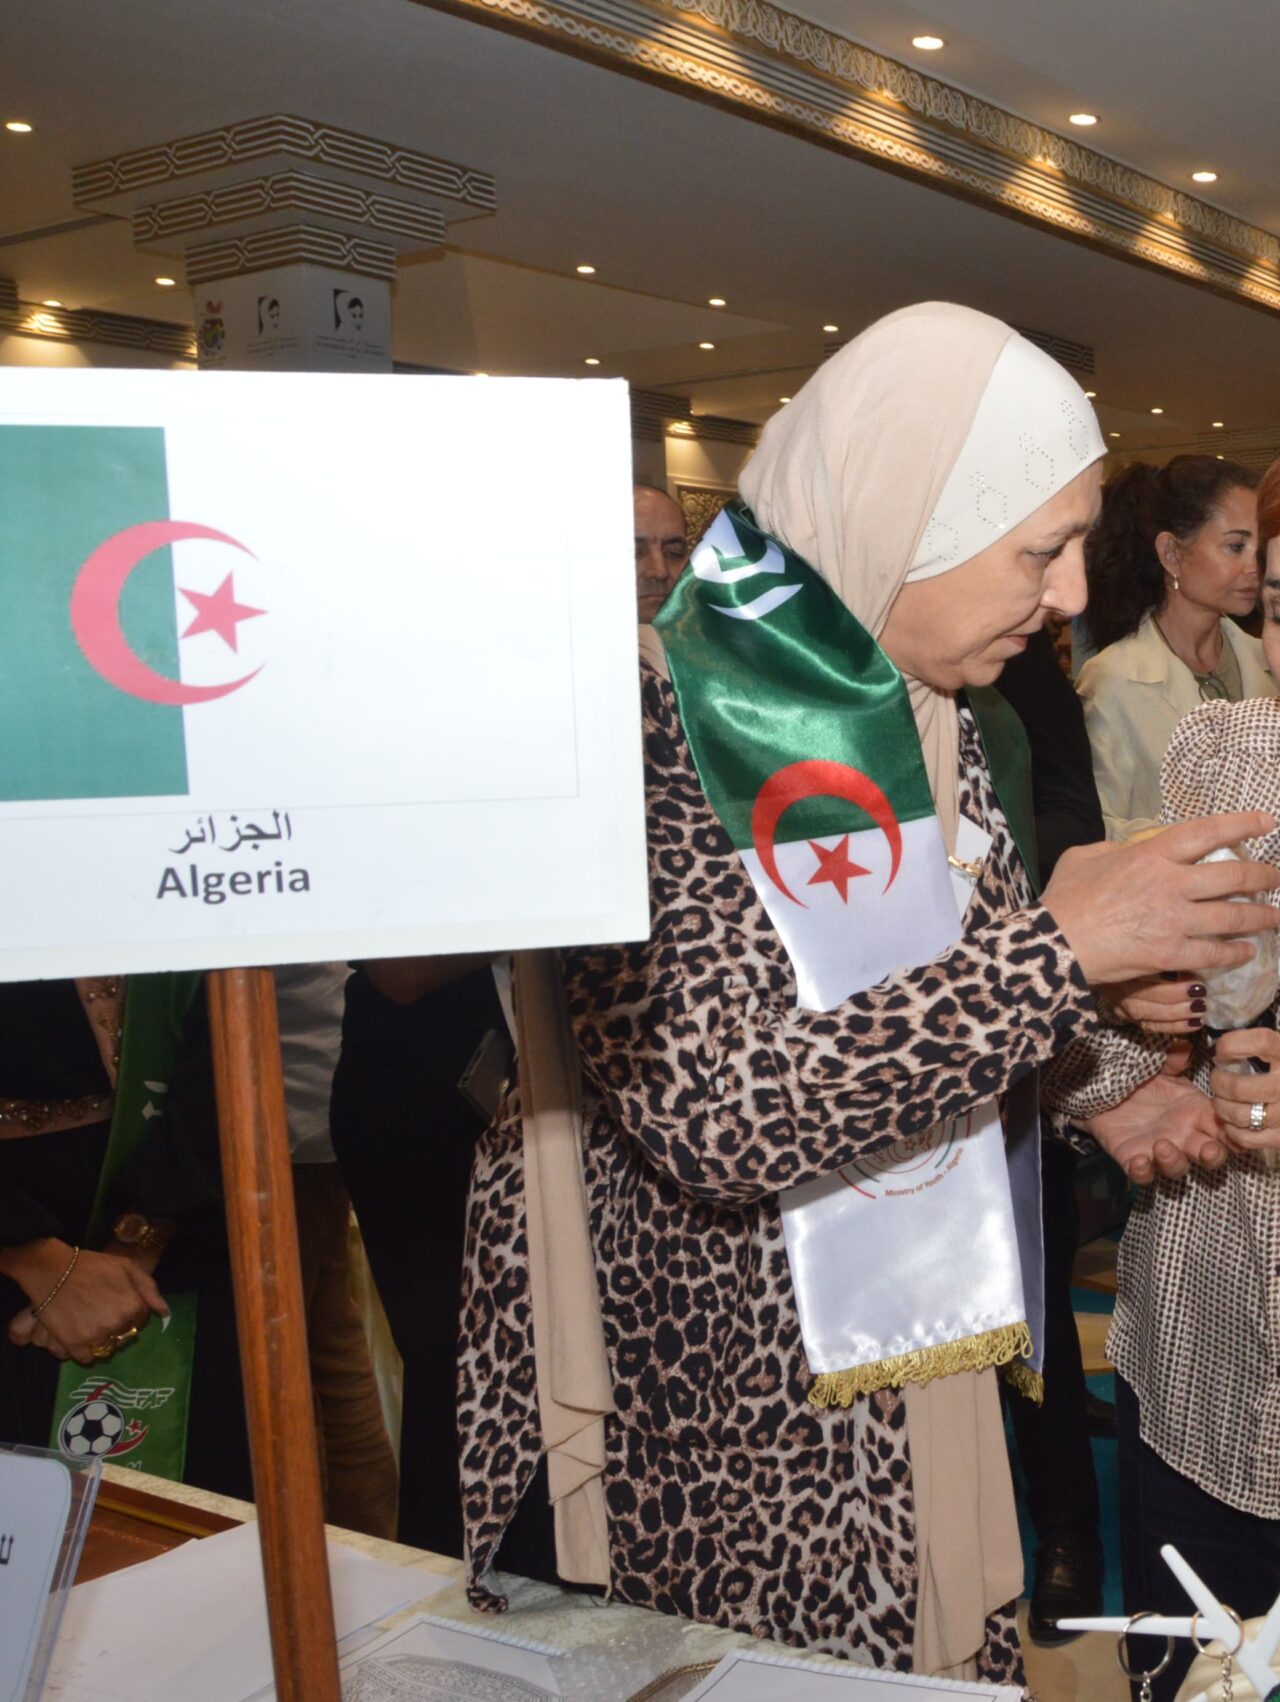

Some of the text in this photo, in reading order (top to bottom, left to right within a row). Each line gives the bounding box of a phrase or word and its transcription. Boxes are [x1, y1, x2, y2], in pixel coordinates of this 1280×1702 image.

[169, 810, 293, 854] الجزائر
[156, 861, 311, 905] Algeria
[885, 1188, 915, 1197] Ministry
